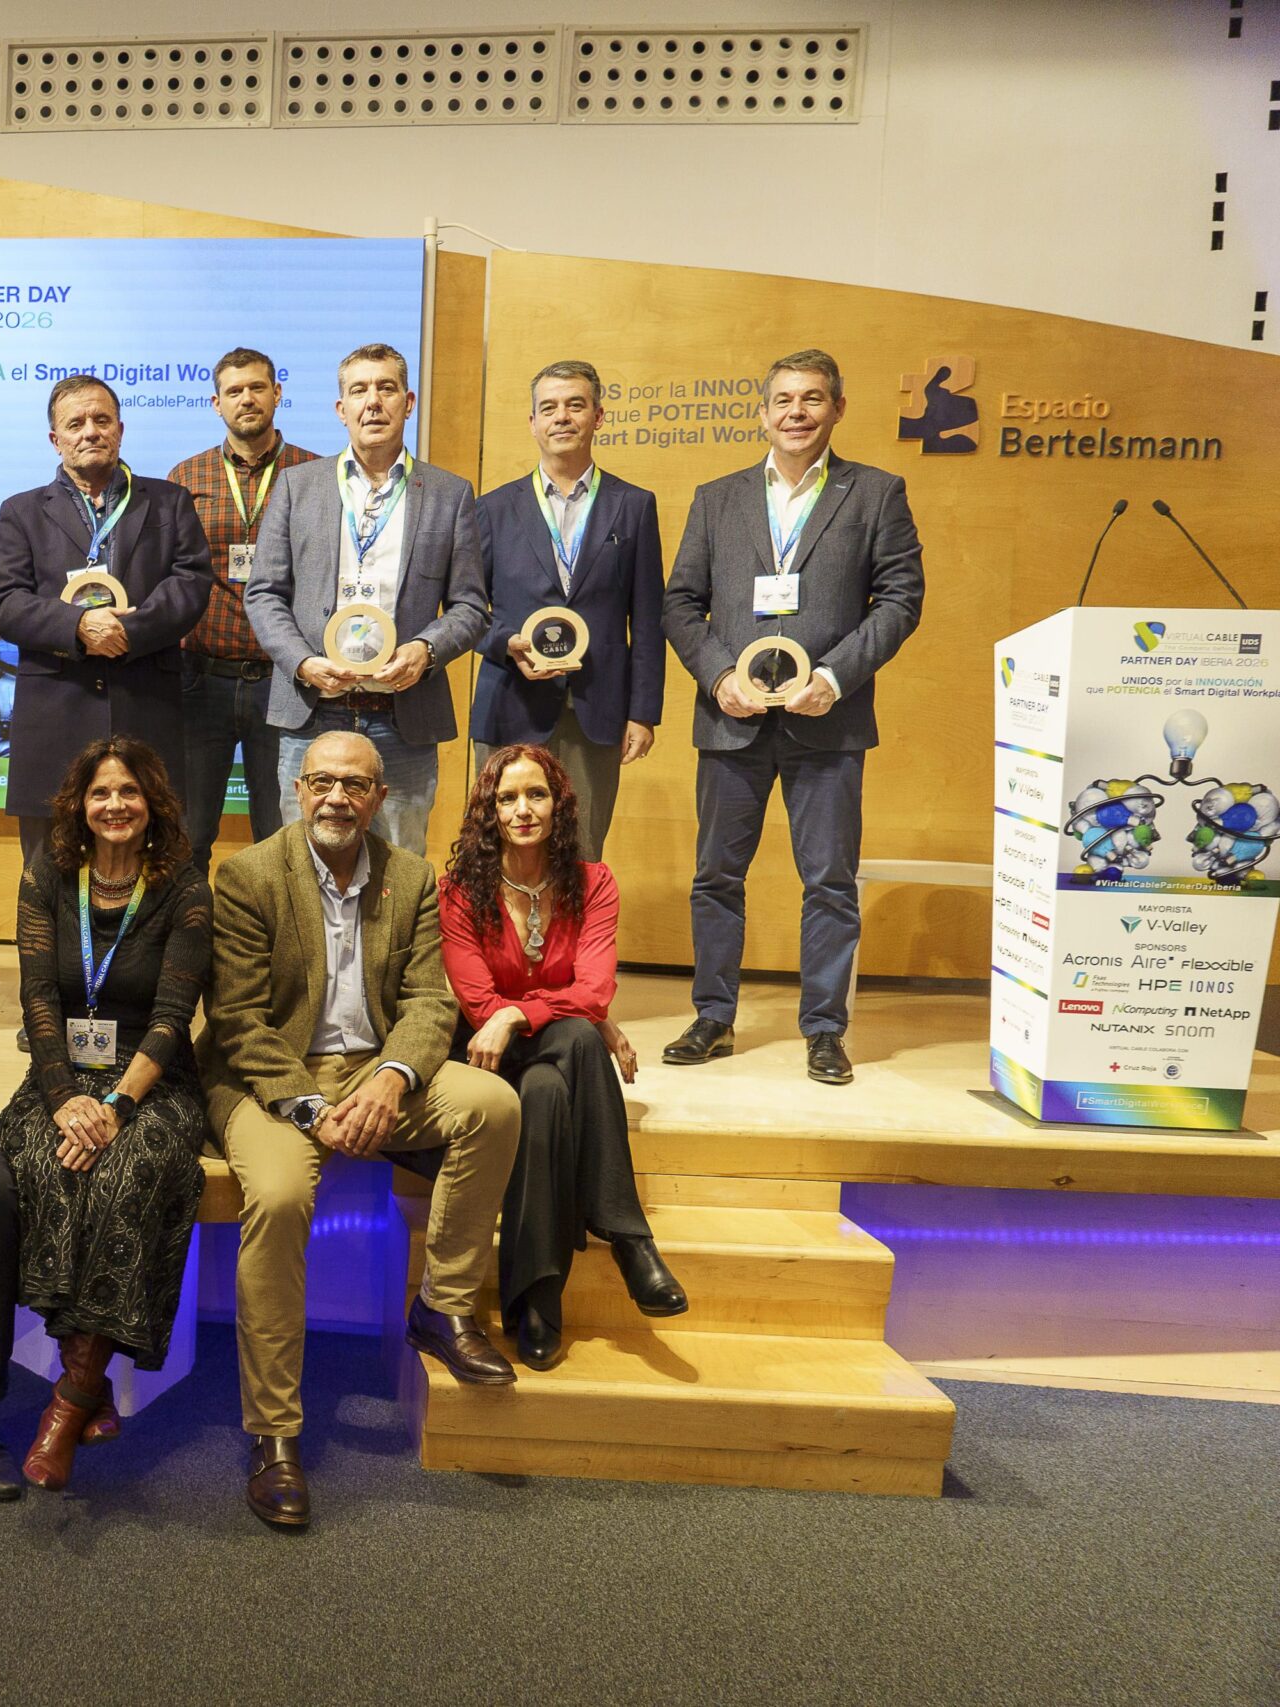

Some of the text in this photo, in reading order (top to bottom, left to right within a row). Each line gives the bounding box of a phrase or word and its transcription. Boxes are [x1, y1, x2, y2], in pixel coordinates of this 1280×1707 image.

[28, 286, 71, 304] DAY
[11, 362, 28, 383] el
[35, 362, 96, 383] Smart
[104, 362, 170, 386] Digital
[629, 384, 663, 403] por
[670, 381, 686, 399] la
[1001, 392, 1111, 424] Espacio
[604, 408, 641, 427] que
[635, 426, 705, 449] Digital
[999, 427, 1223, 460] Bertelsmann
[542, 646, 568, 654] CABLE
[1241, 638, 1259, 646] UDS
[1120, 656, 1269, 667] PARTNER DAY IBERIA 2026
[1121, 676, 1263, 687] UNIDOS por la INNOVACIÓN
[1086, 685, 1280, 699] que POTENCIA el Smart Digital Workpla
[1095, 879, 1242, 892] #VirtualCablePartnerDayIberia
[1138, 904, 1192, 914] MAYORISTA
[1147, 919, 1208, 936] V-Valley
[1134, 943, 1187, 952] SPONSORS
[1063, 953, 1123, 967] Acronis
[1131, 955, 1167, 970] Aire
[1138, 979, 1183, 992] HPE
[1190, 980, 1234, 994] IONOS
[1061, 1002, 1251, 1020] Lenovo NComputing NetApp
[1090, 1023, 1215, 1038] NUTANIX snom
